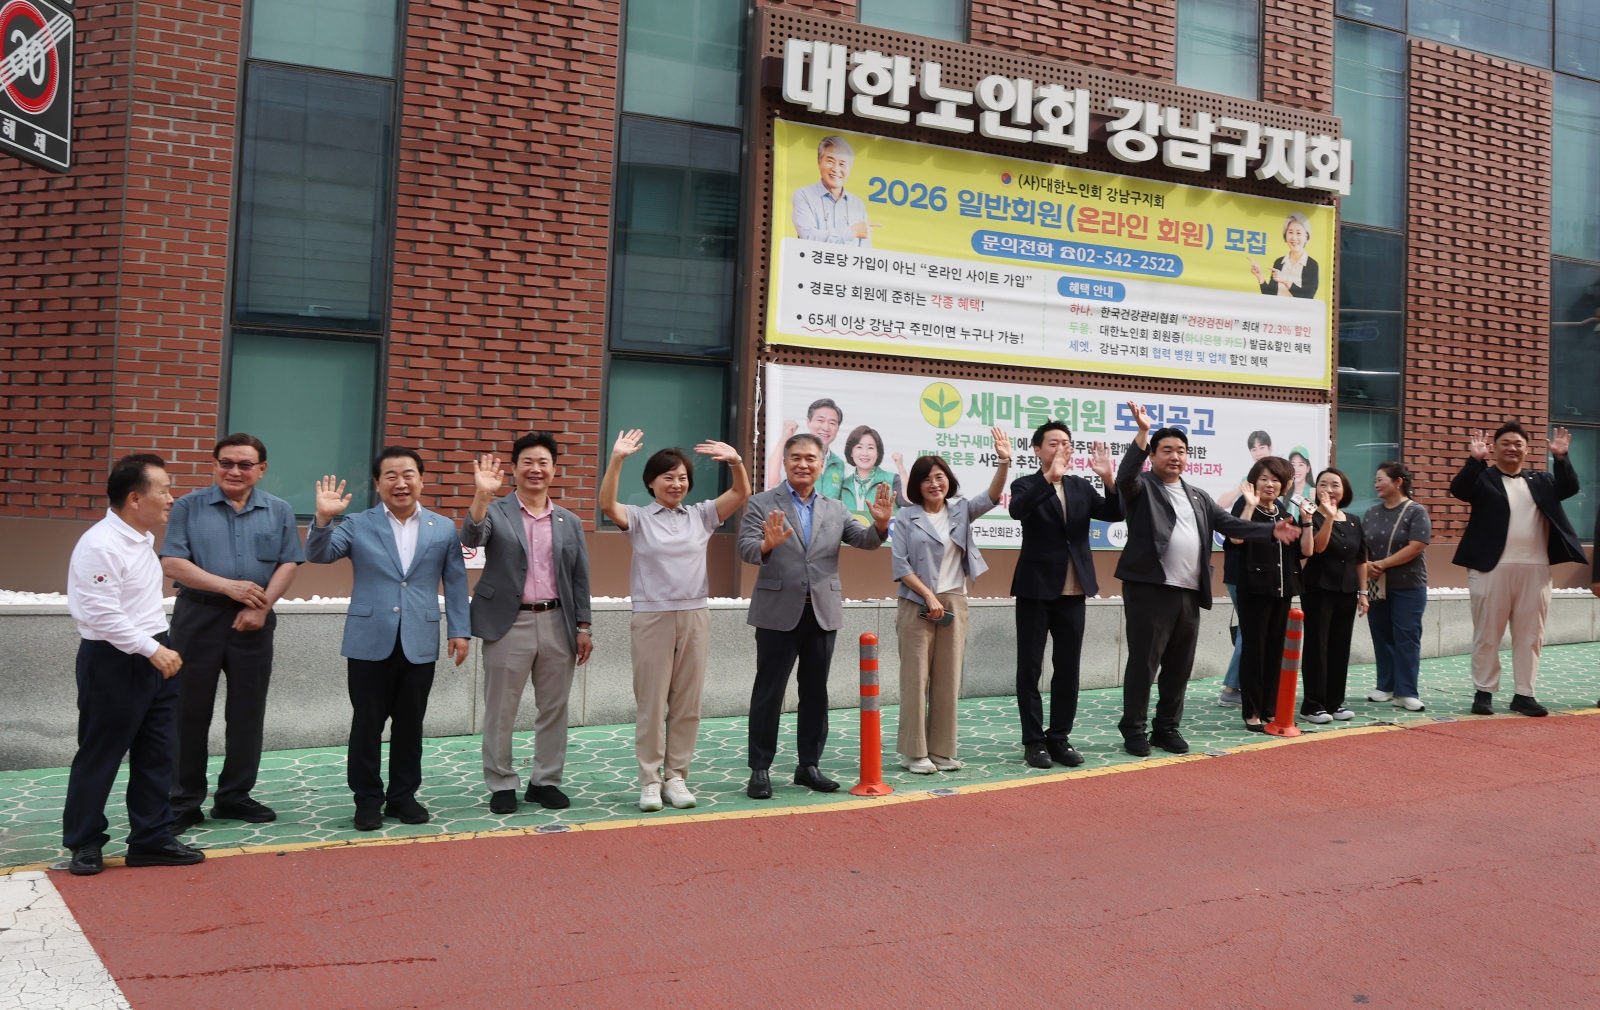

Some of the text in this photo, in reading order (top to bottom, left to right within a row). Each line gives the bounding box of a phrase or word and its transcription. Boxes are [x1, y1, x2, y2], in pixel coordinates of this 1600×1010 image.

[782, 37, 1352, 197] 대한노인회 강남구지회
[1018, 173, 1165, 209] (사)대한노인회 강남구지회
[868, 176, 947, 212] 2026
[1157, 217, 1214, 250] 회원)
[1224, 227, 1267, 256] 모집
[981, 234, 1054, 259] 문의전화
[811, 250, 848, 268] 경로당
[852, 256, 888, 273] 가입이
[892, 261, 916, 276] 아닌
[966, 269, 1000, 284] 사이트
[810, 281, 985, 312] 경로당 회원에 준하는 각종 혜택!
[1069, 281, 1114, 299] 혜택 안내
[808, 313, 1024, 344] 65세 이상 강남구 주민이면 누구나 가능!
[1070, 303, 1094, 317] 하나.
[1100, 306, 1179, 325] 한국건강관리협회
[1241, 320, 1260, 333] 최대
[1262, 323, 1292, 336] 72.3%
[1294, 325, 1312, 338] 할인
[1099, 325, 1149, 341] 대한노인회
[1249, 338, 1292, 353] 발급&할인
[1294, 342, 1312, 354] 혜택
[1099, 343, 1149, 358] 강남구지회
[1152, 347, 1171, 360] 협력
[1174, 349, 1193, 362] 병원
[1196, 351, 1206, 363] 및
[1208, 352, 1227, 365] 업체
[1229, 354, 1248, 367] 할인
[1250, 355, 1268, 368] 혜택
[966, 392, 1106, 433] 새마을회원
[979, 453, 1012, 468] 사업
[1016, 455, 1042, 469] 추진
[1183, 462, 1223, 477] 여하고자
[1186, 446, 1207, 460] 위한
[970, 526, 1014, 538] 구노인회관
